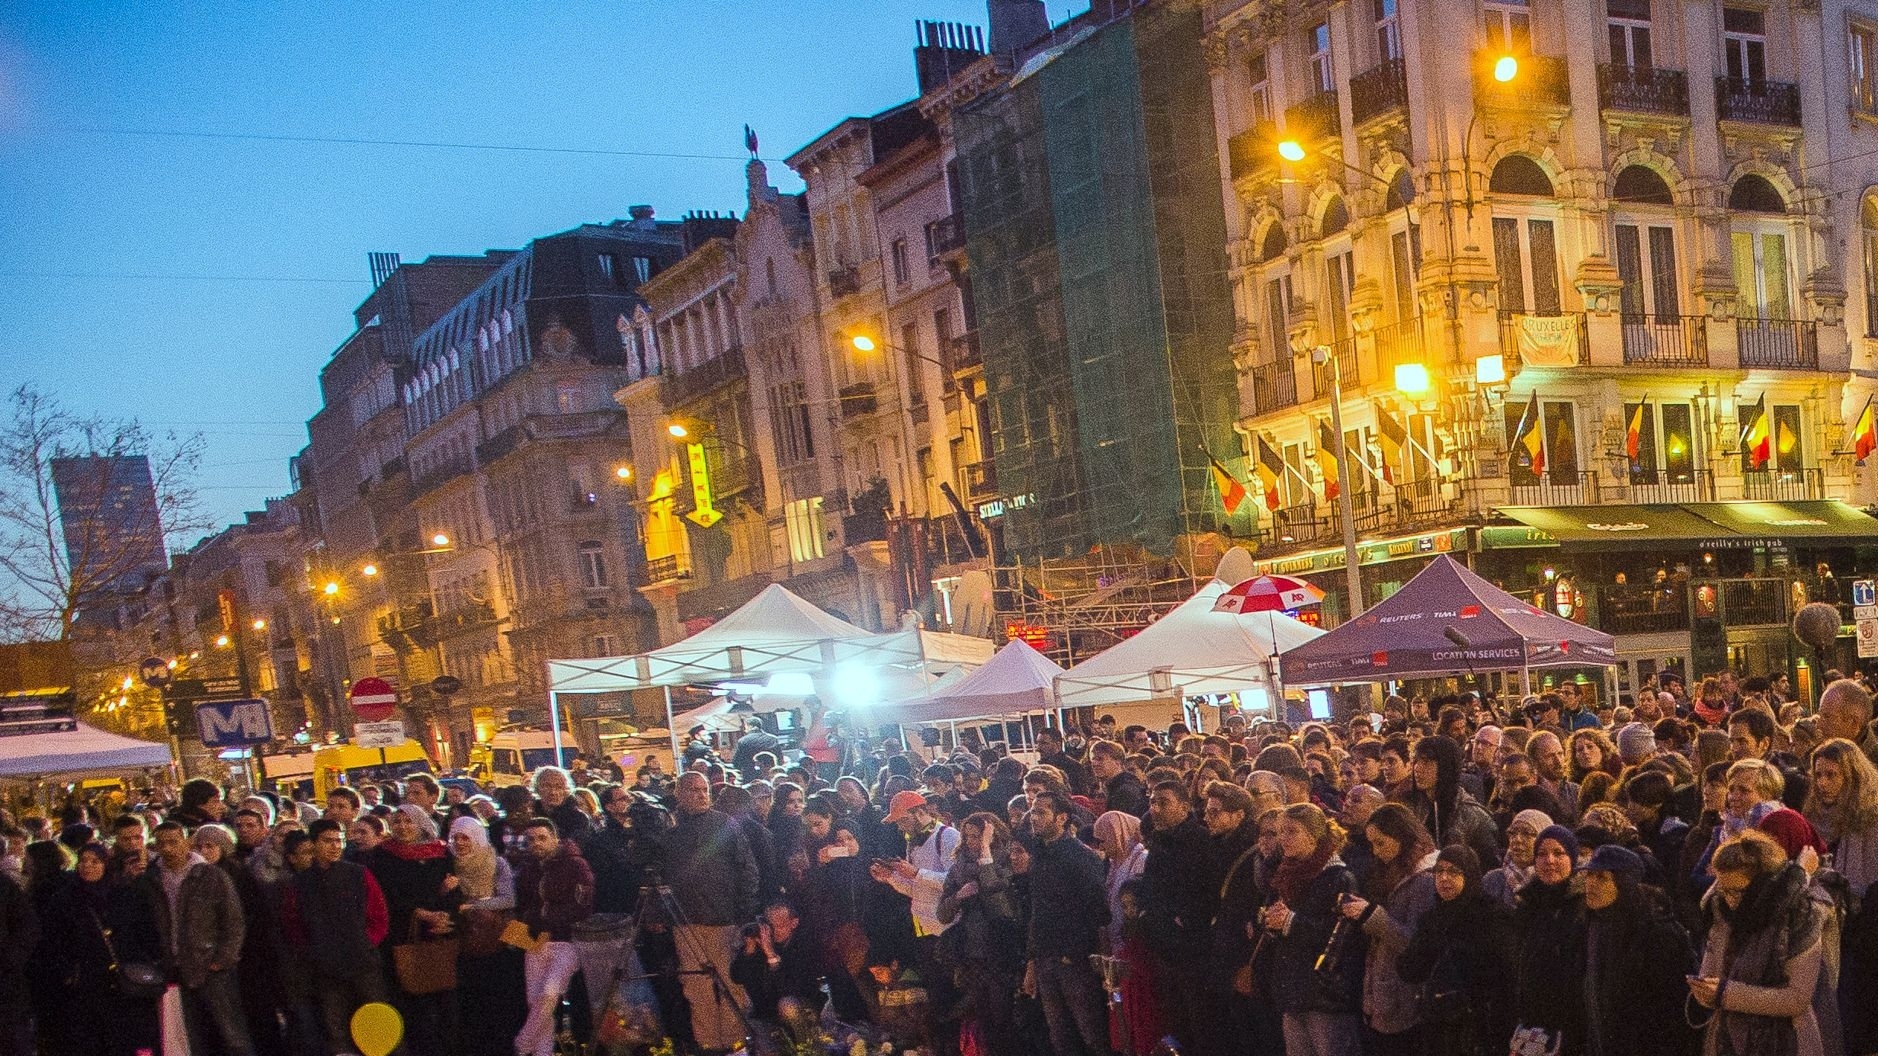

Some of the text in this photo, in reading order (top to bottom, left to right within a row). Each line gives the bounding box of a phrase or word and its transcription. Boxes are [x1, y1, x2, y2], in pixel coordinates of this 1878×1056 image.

[1522, 318, 1575, 332] BRUXELLES
[1743, 539, 1765, 548] irish
[1766, 538, 1783, 548] pub
[1380, 612, 1423, 624] REUTERS
[1478, 648, 1520, 659] SERVICES
